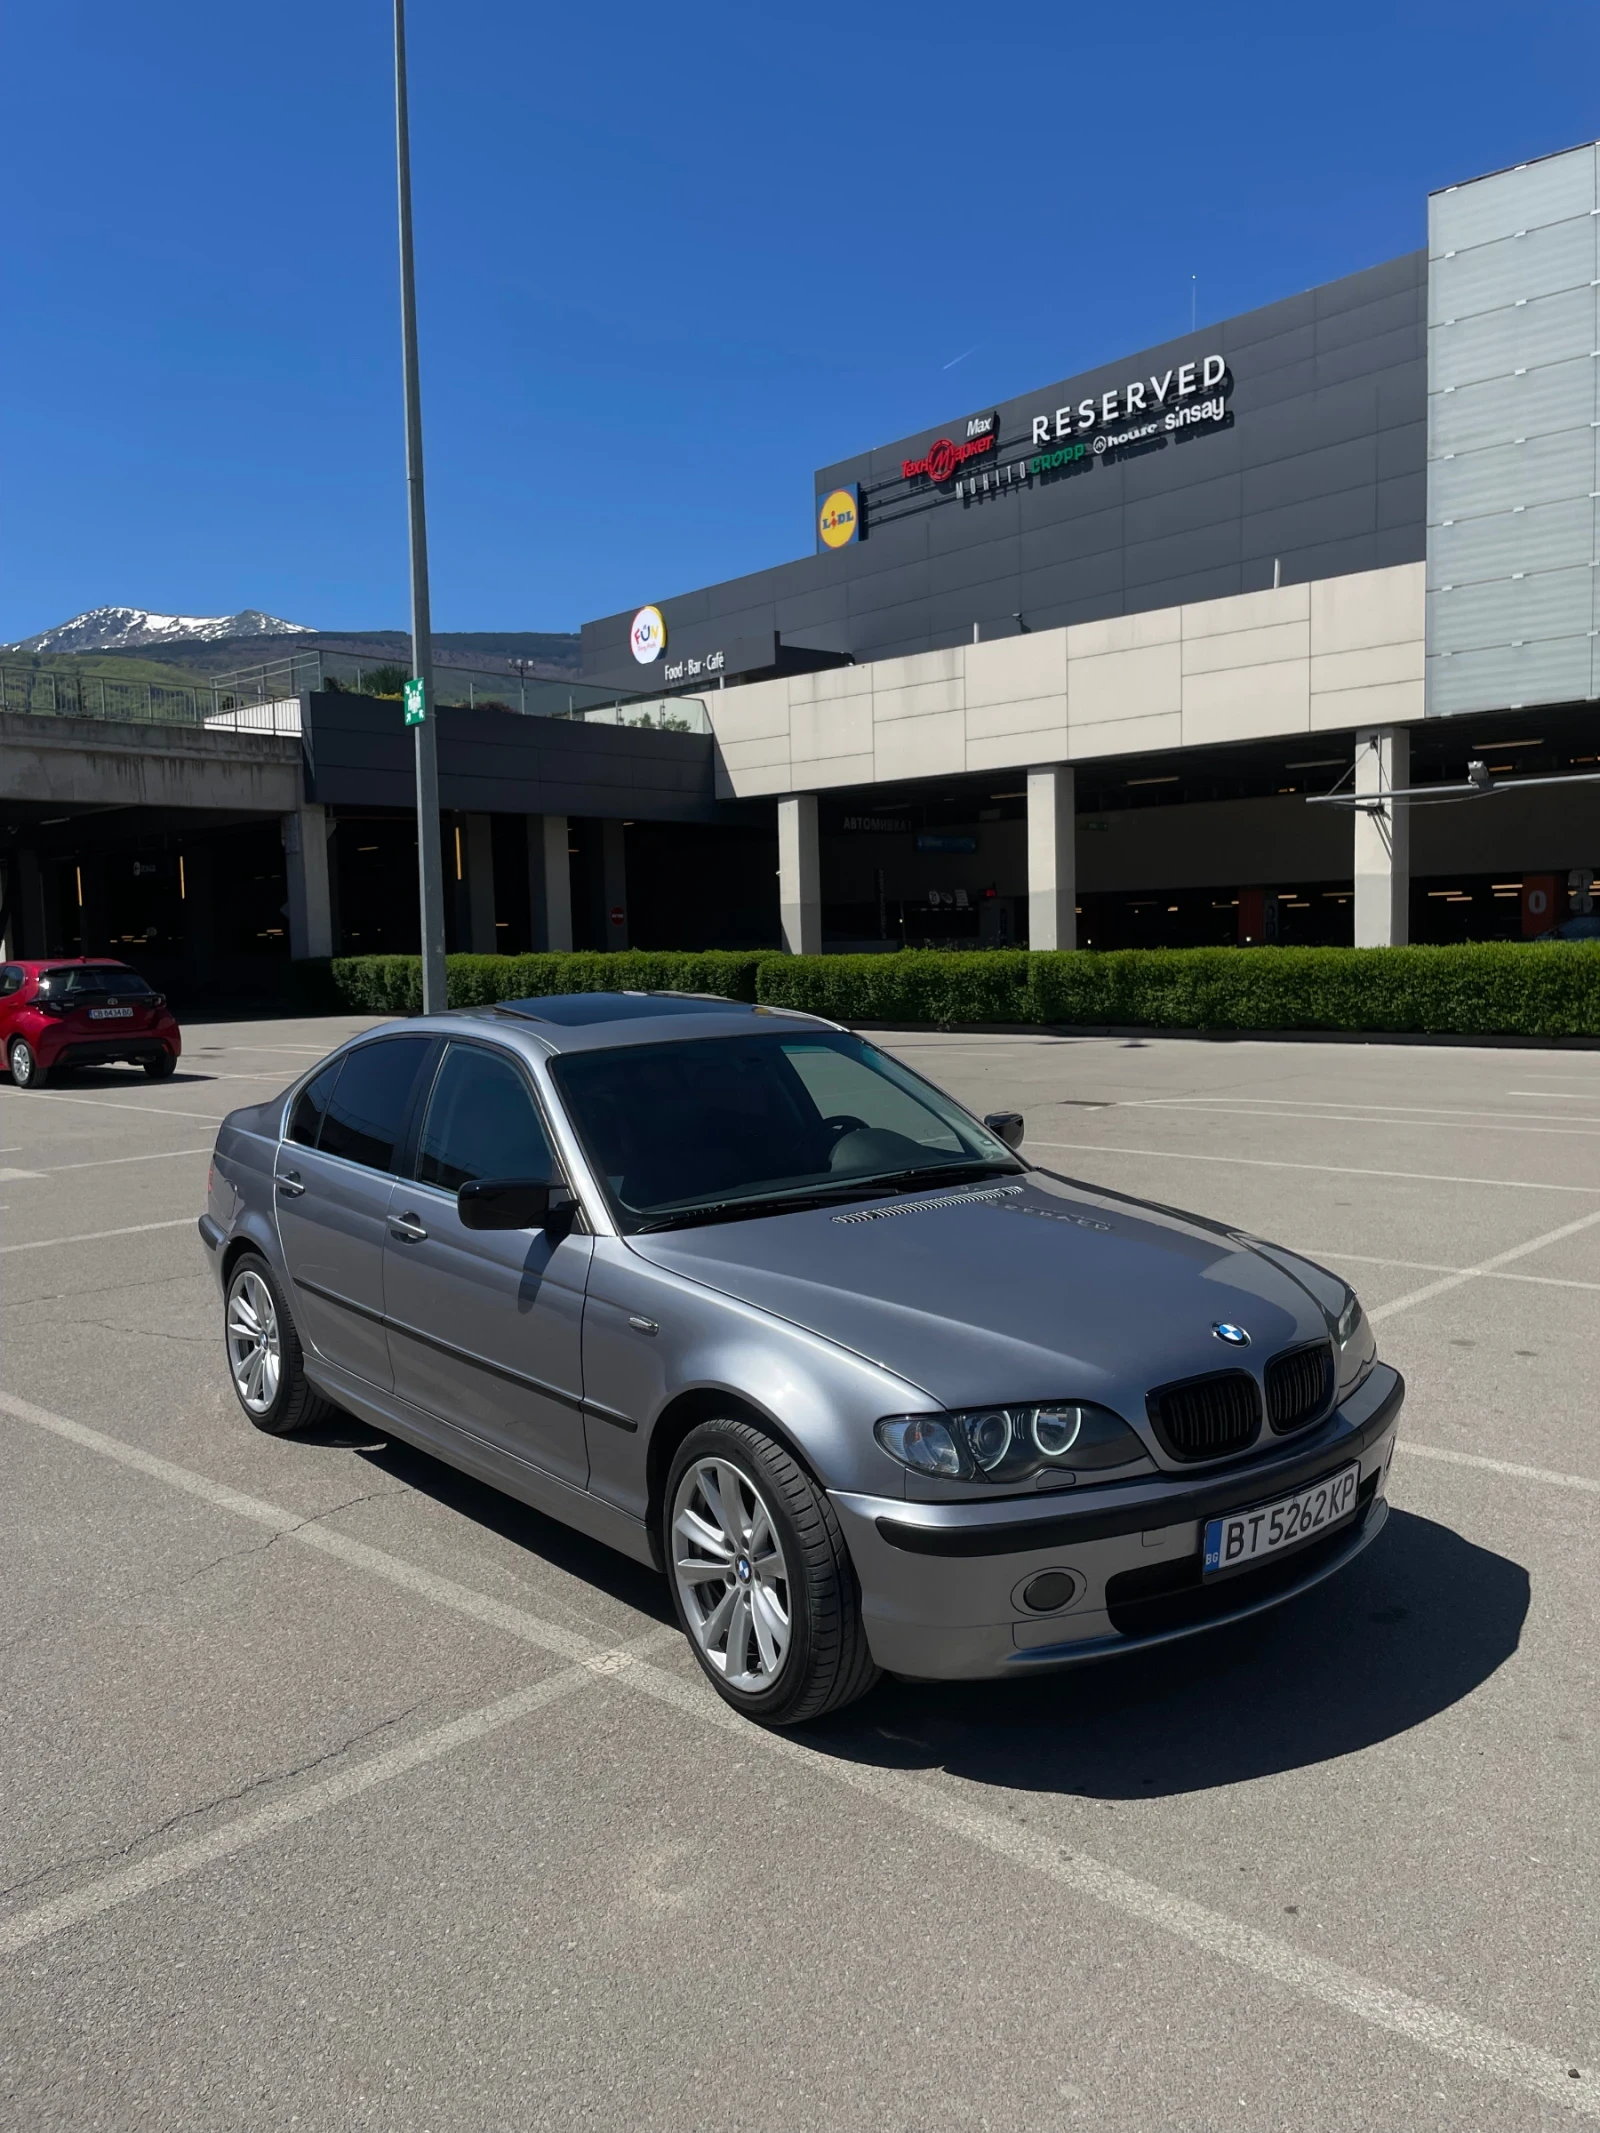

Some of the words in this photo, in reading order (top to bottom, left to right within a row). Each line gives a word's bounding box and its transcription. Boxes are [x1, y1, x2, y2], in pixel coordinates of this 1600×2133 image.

[1032, 354, 1226, 445] RESERVED
[966, 417, 992, 437] Max
[1164, 396, 1225, 431] sinsay
[1107, 423, 1158, 448] house
[955, 461, 1026, 499] MOHITO
[634, 624, 659, 645] FUN
[664, 661, 683, 680] Food
[687, 658, 701, 676] Bar
[706, 651, 724, 670] Café
[1205, 1552, 1219, 1565] BG
